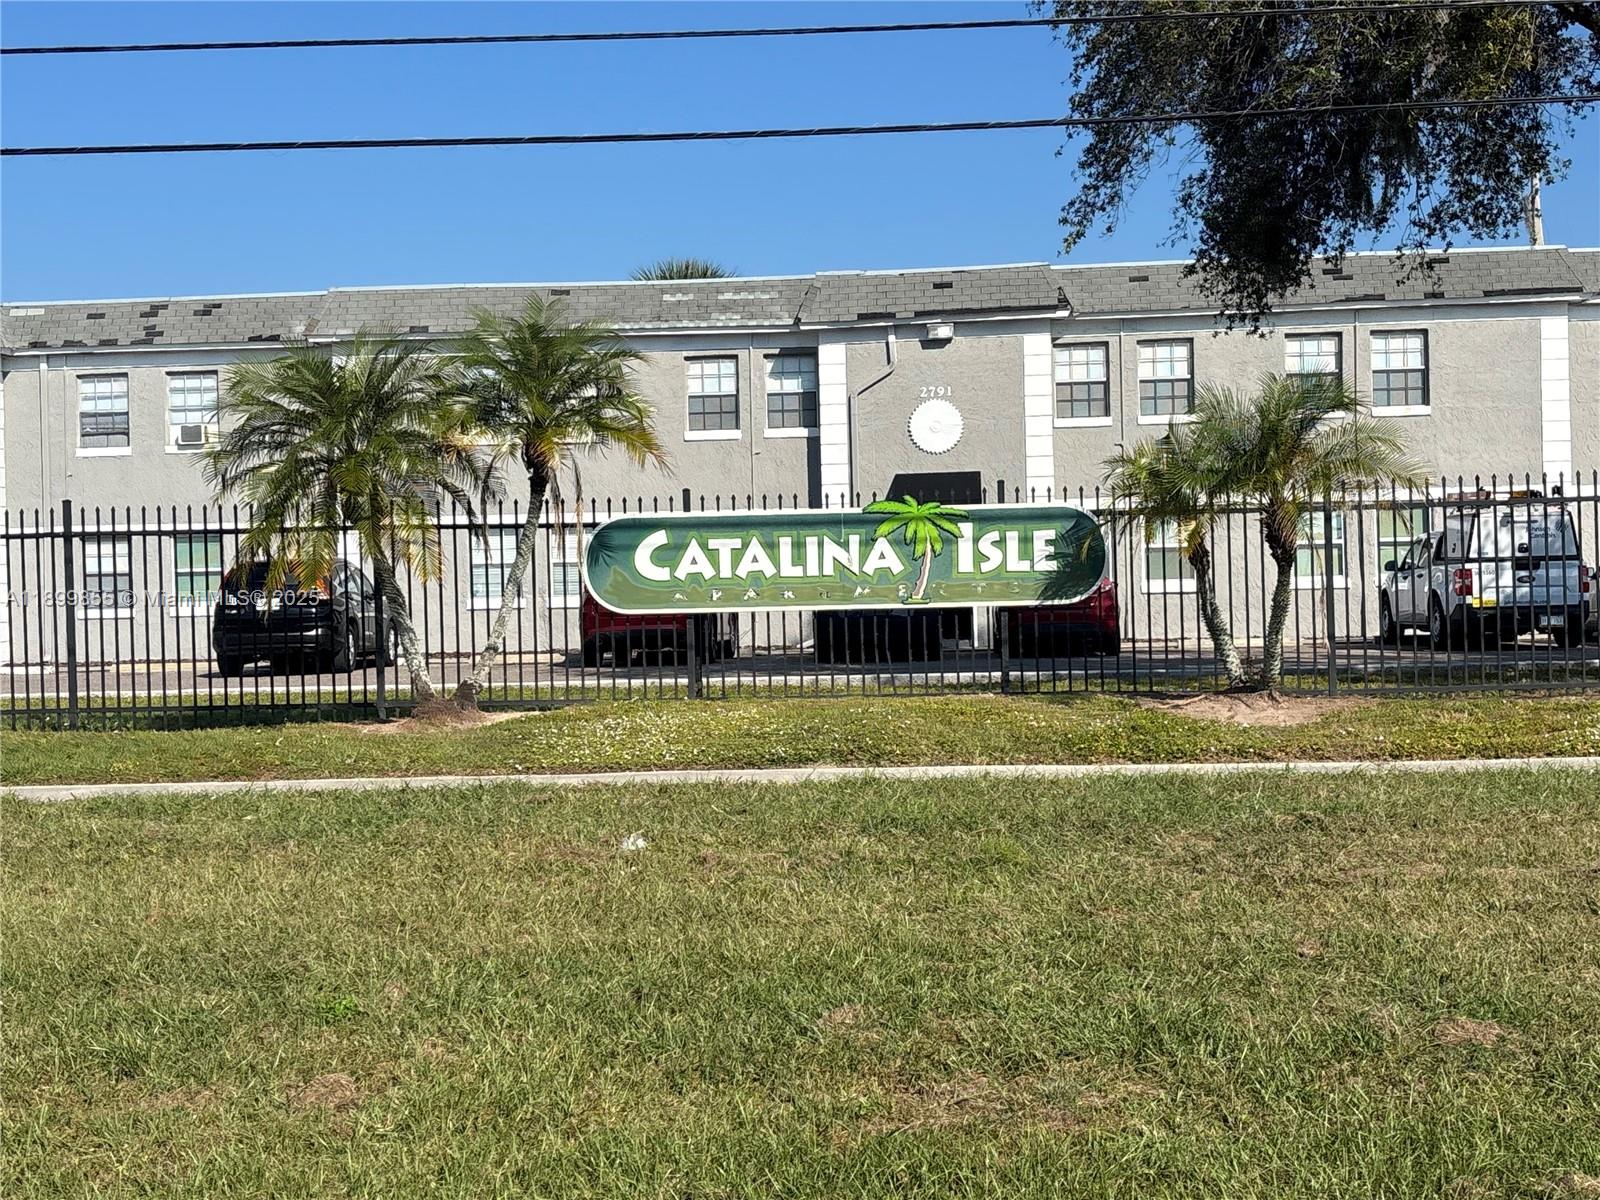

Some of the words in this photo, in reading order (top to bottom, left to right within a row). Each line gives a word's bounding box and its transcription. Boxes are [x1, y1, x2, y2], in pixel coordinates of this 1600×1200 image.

[919, 386, 952, 398] 2791
[634, 529, 905, 581] CATALINA
[957, 522, 1058, 574] ISLE
